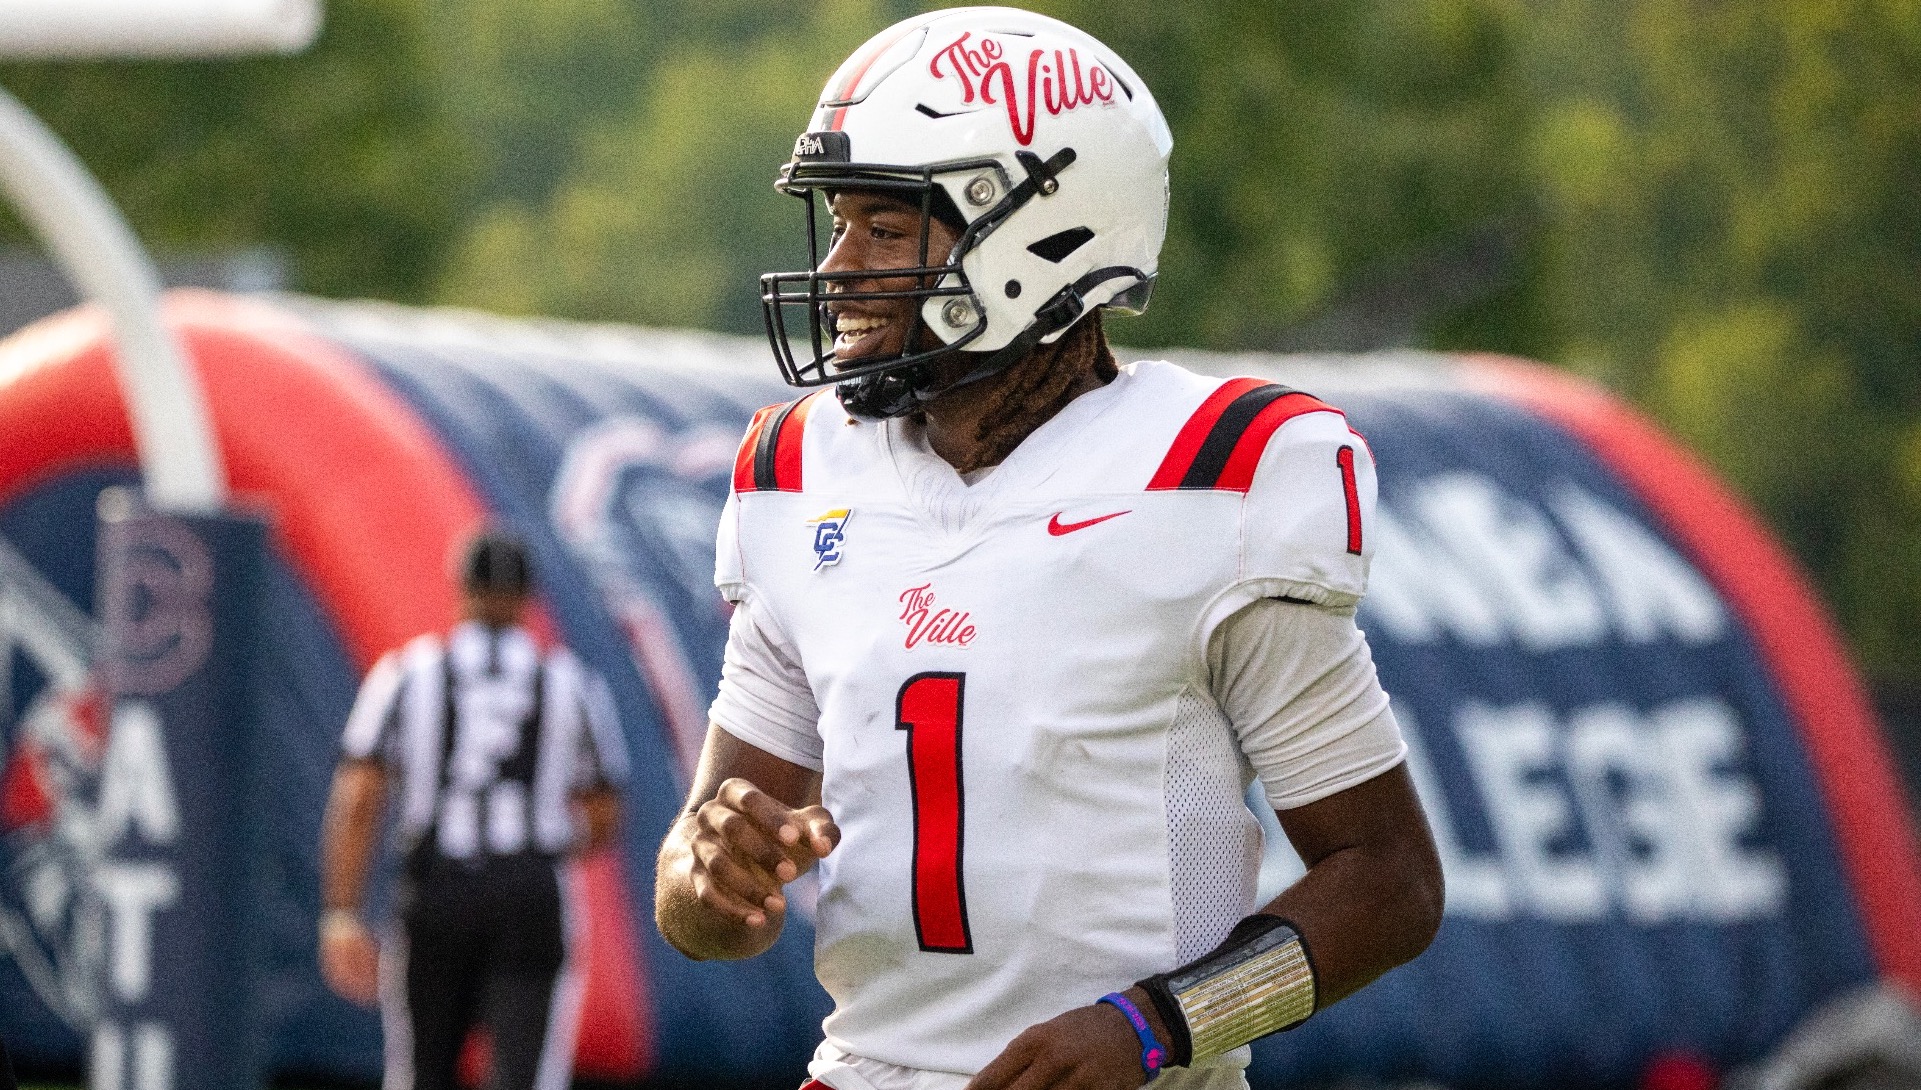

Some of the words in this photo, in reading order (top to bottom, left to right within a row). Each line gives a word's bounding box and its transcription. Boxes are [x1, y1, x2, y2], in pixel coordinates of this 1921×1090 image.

[930, 31, 1003, 103] The
[980, 48, 1113, 147] Ville
[1336, 444, 1363, 556] 1
[899, 582, 936, 620] The
[905, 608, 977, 649] Ville
[894, 671, 974, 955] 1
